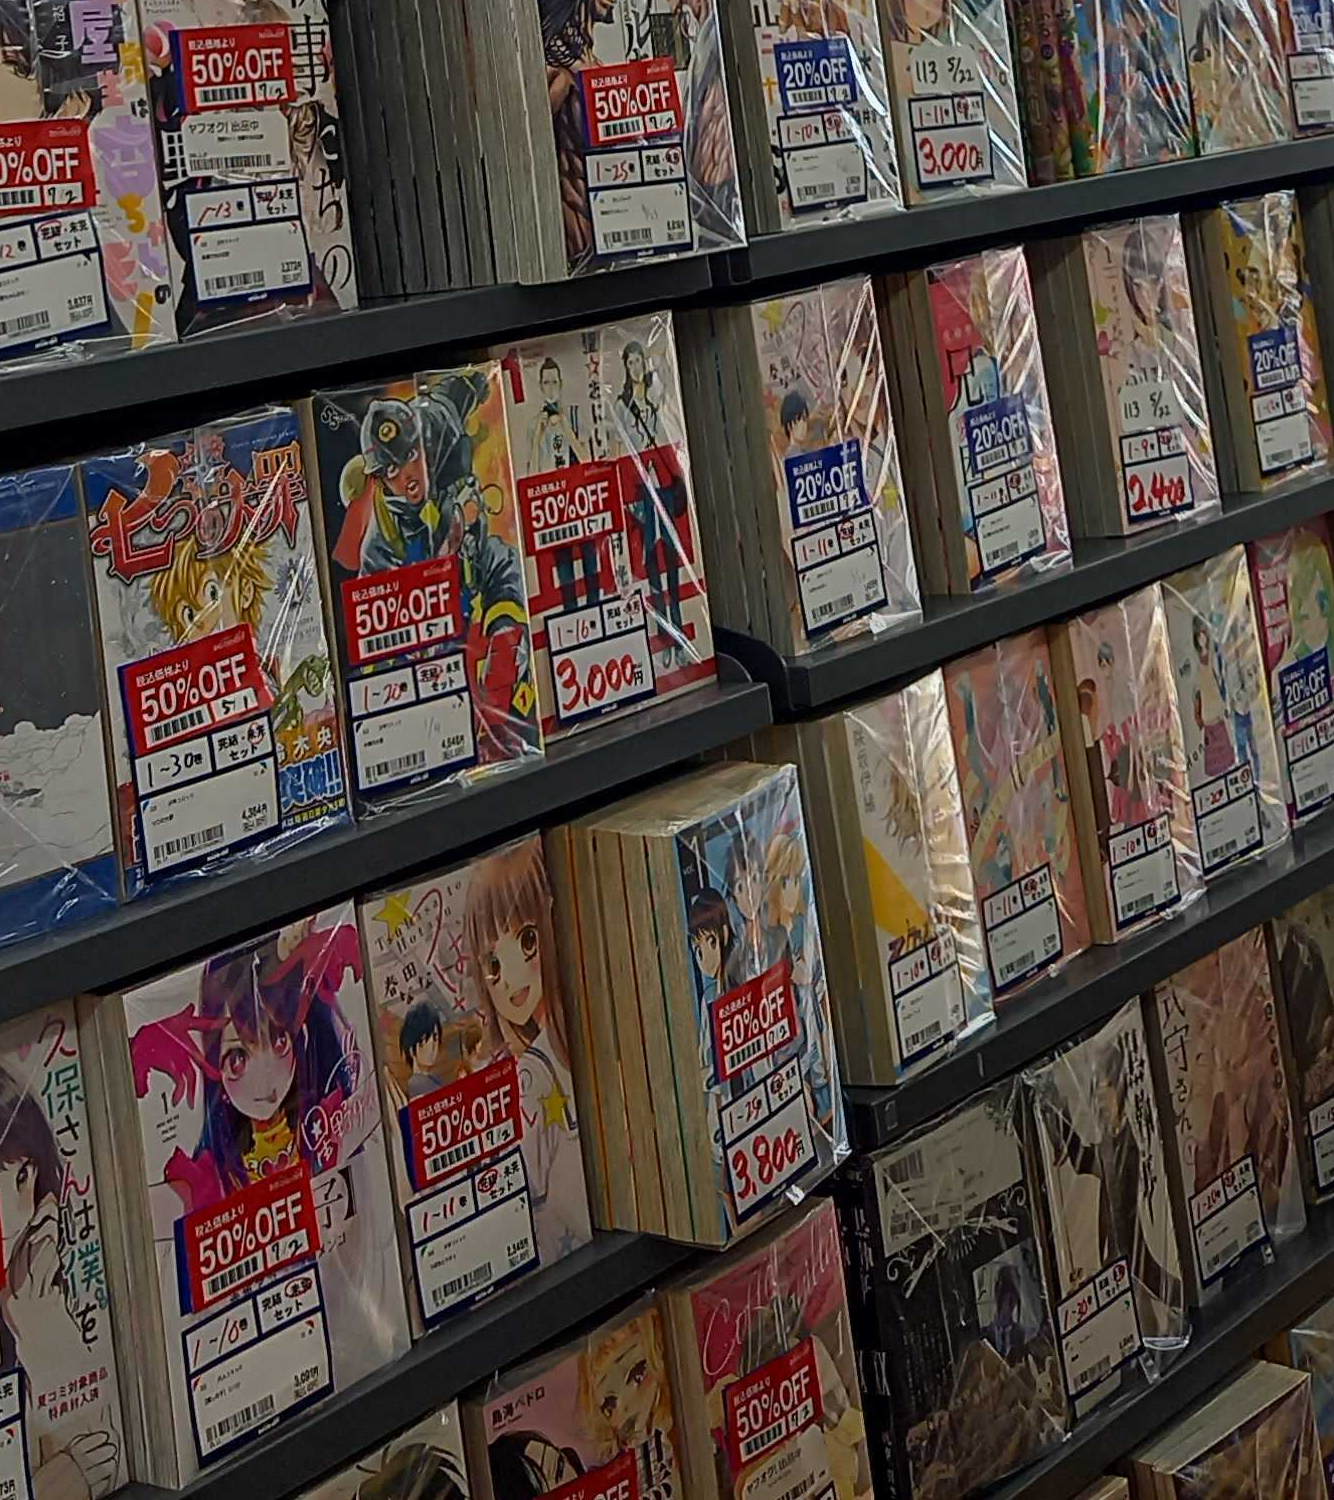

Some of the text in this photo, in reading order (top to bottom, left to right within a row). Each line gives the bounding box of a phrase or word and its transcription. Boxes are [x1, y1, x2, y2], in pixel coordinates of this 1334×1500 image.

[191, 47, 284, 84] 50%OFF
[782, 56, 849, 89] 20%OFF
[595, 81, 672, 121] 50%OFF
[1253, 342, 1297, 371] 20%OFF
[971, 415, 1028, 453] 20%OFF
[794, 460, 858, 504] 20%OFF
[530, 481, 610, 528] 50%OFF
[355, 579, 451, 635] 50%OFF
[140, 652, 248, 722] 50%OFF
[1284, 666, 1327, 708] 20%OFF
[721, 984, 785, 1052] 50%OFF
[421, 1084, 513, 1155] 50%OFF
[197, 1191, 304, 1275] 50%OFF
[273, 1300, 304, 1322] セット
[735, 1365, 811, 1439] 50%OFF
